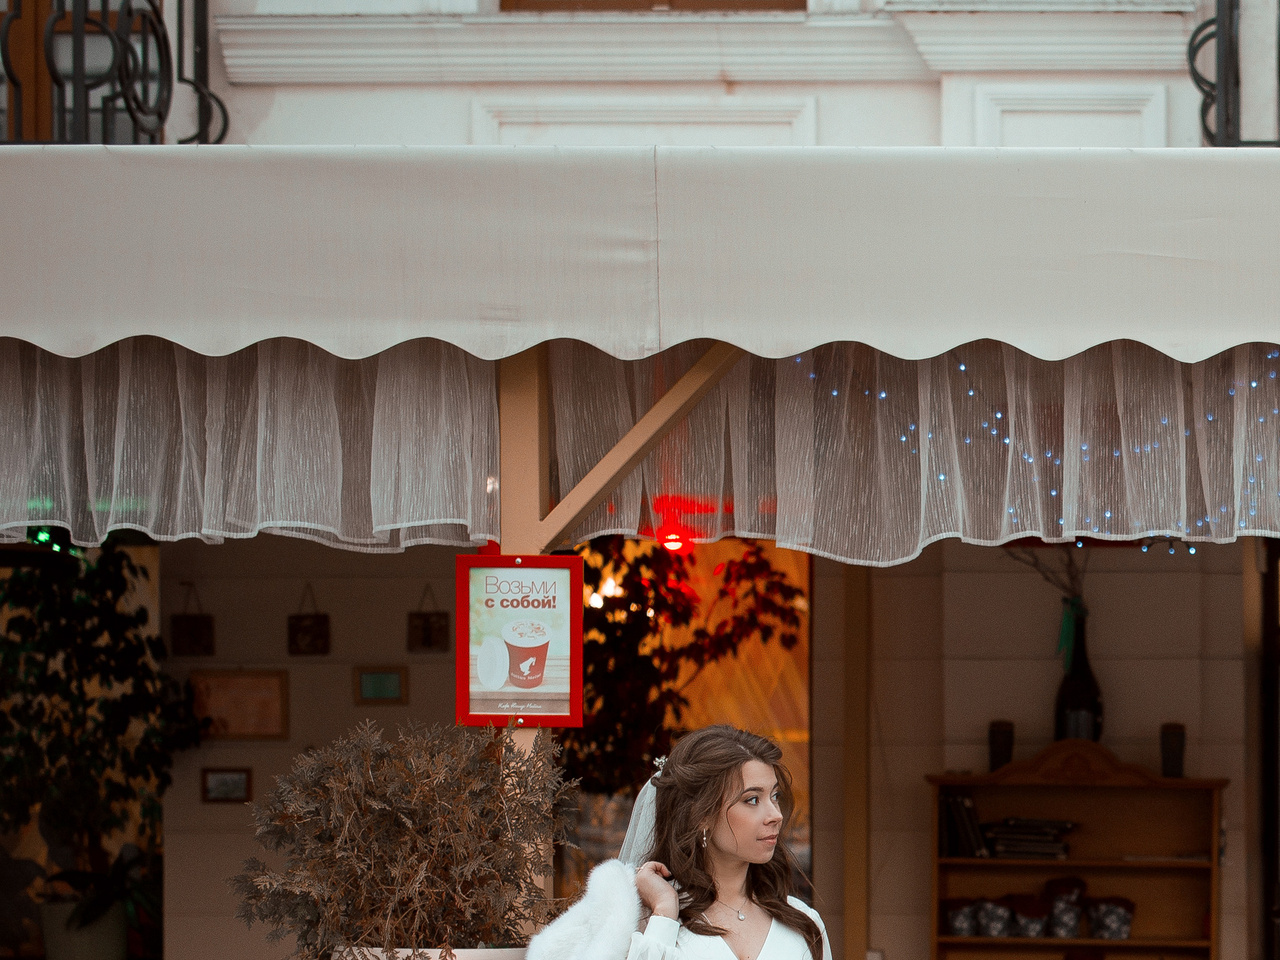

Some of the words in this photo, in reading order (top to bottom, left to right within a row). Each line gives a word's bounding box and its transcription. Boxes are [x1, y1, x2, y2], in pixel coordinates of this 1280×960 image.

[485, 575, 557, 595] Возьми
[484, 598, 495, 609] с
[500, 595, 557, 609] собой!
